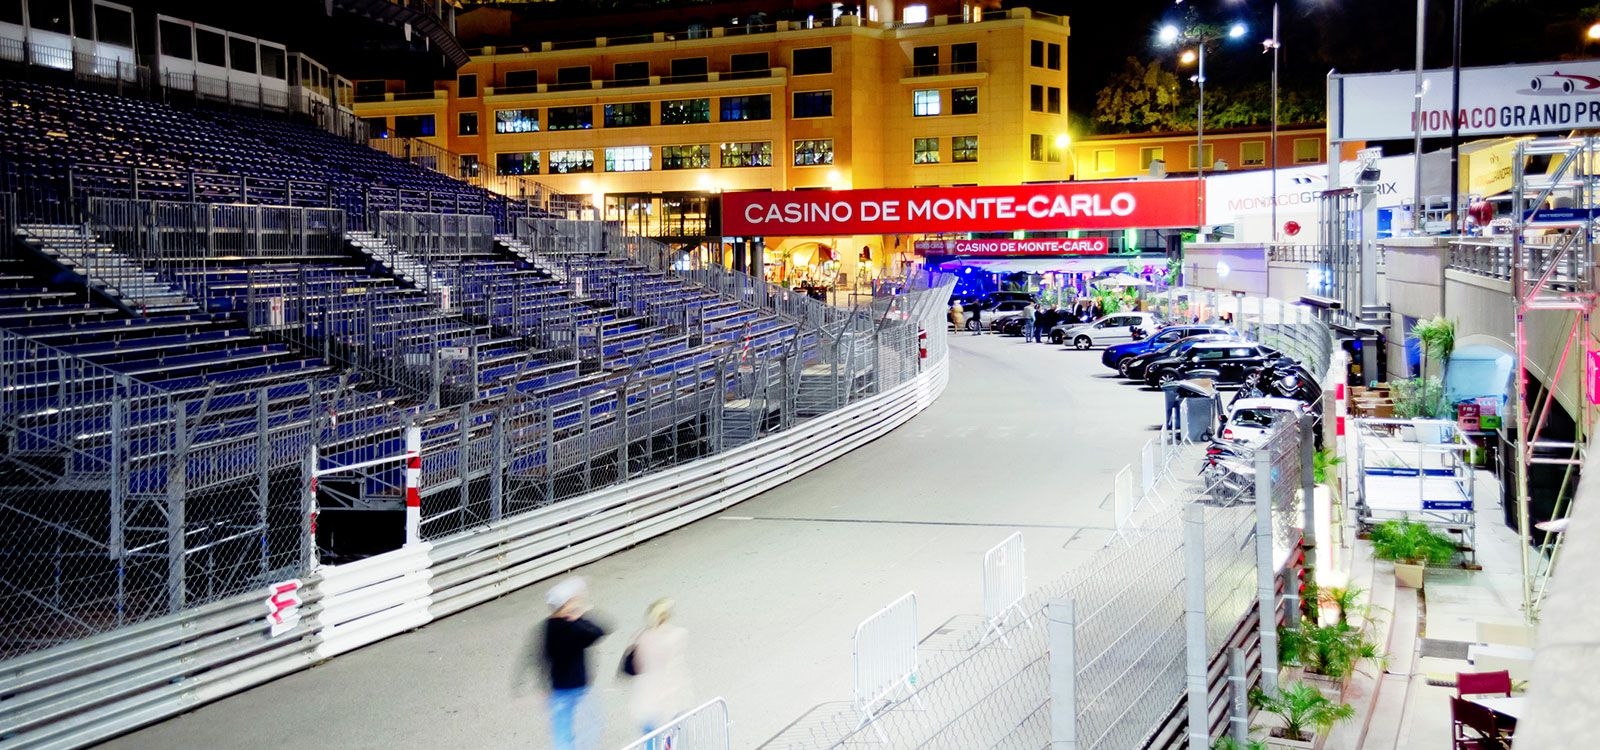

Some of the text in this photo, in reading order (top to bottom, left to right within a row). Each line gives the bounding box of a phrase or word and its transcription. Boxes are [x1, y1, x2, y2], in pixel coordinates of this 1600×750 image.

[744, 191, 1137, 224] CASINO DE MONTE-CARLO
[955, 242, 999, 253] CASINO
[1001, 242, 1016, 252] DE
[1017, 240, 1104, 252] MONTE-CARLO
